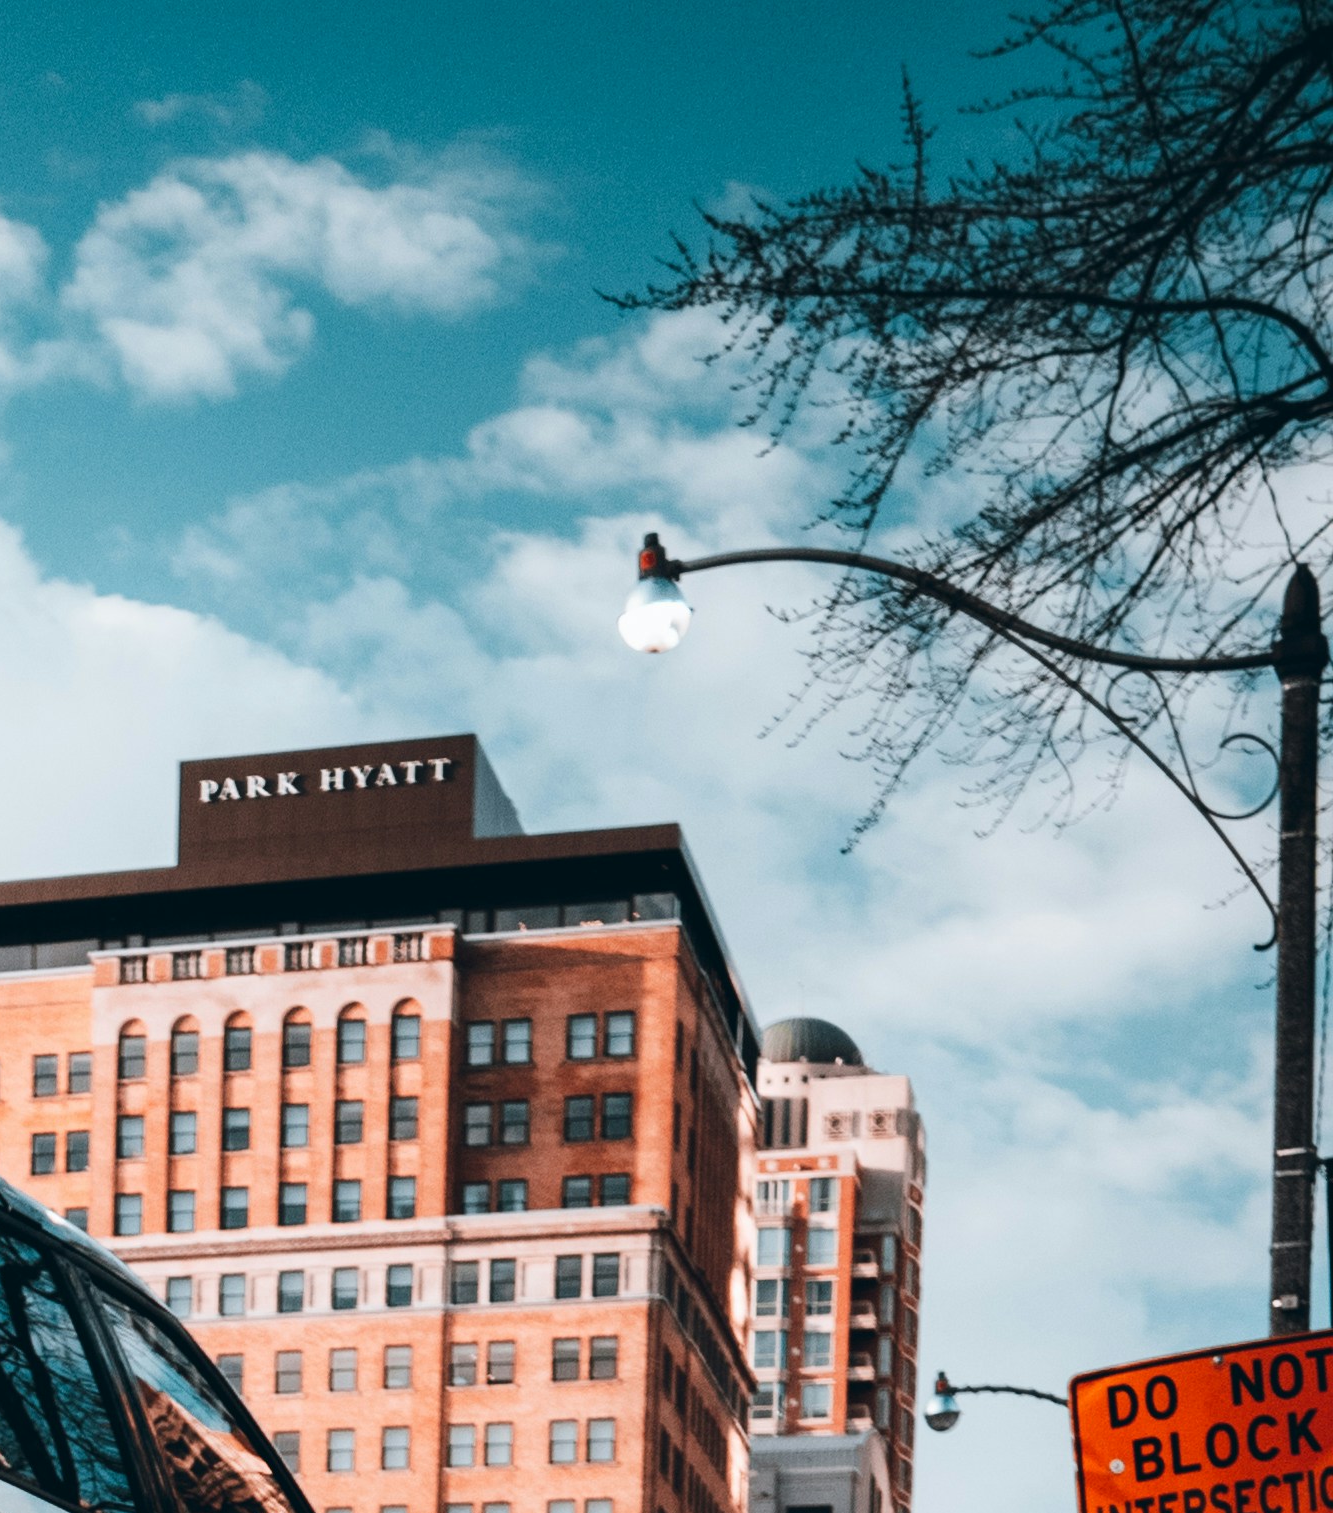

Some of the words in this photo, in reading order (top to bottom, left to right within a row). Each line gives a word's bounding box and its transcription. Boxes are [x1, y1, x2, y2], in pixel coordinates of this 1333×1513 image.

[199, 771, 301, 803] PARK
[319, 758, 452, 792] HYATT
[1107, 1375, 1178, 1429] DO
[1229, 1348, 1333, 1406] NOT
[1132, 1408, 1322, 1482] BLOCK
